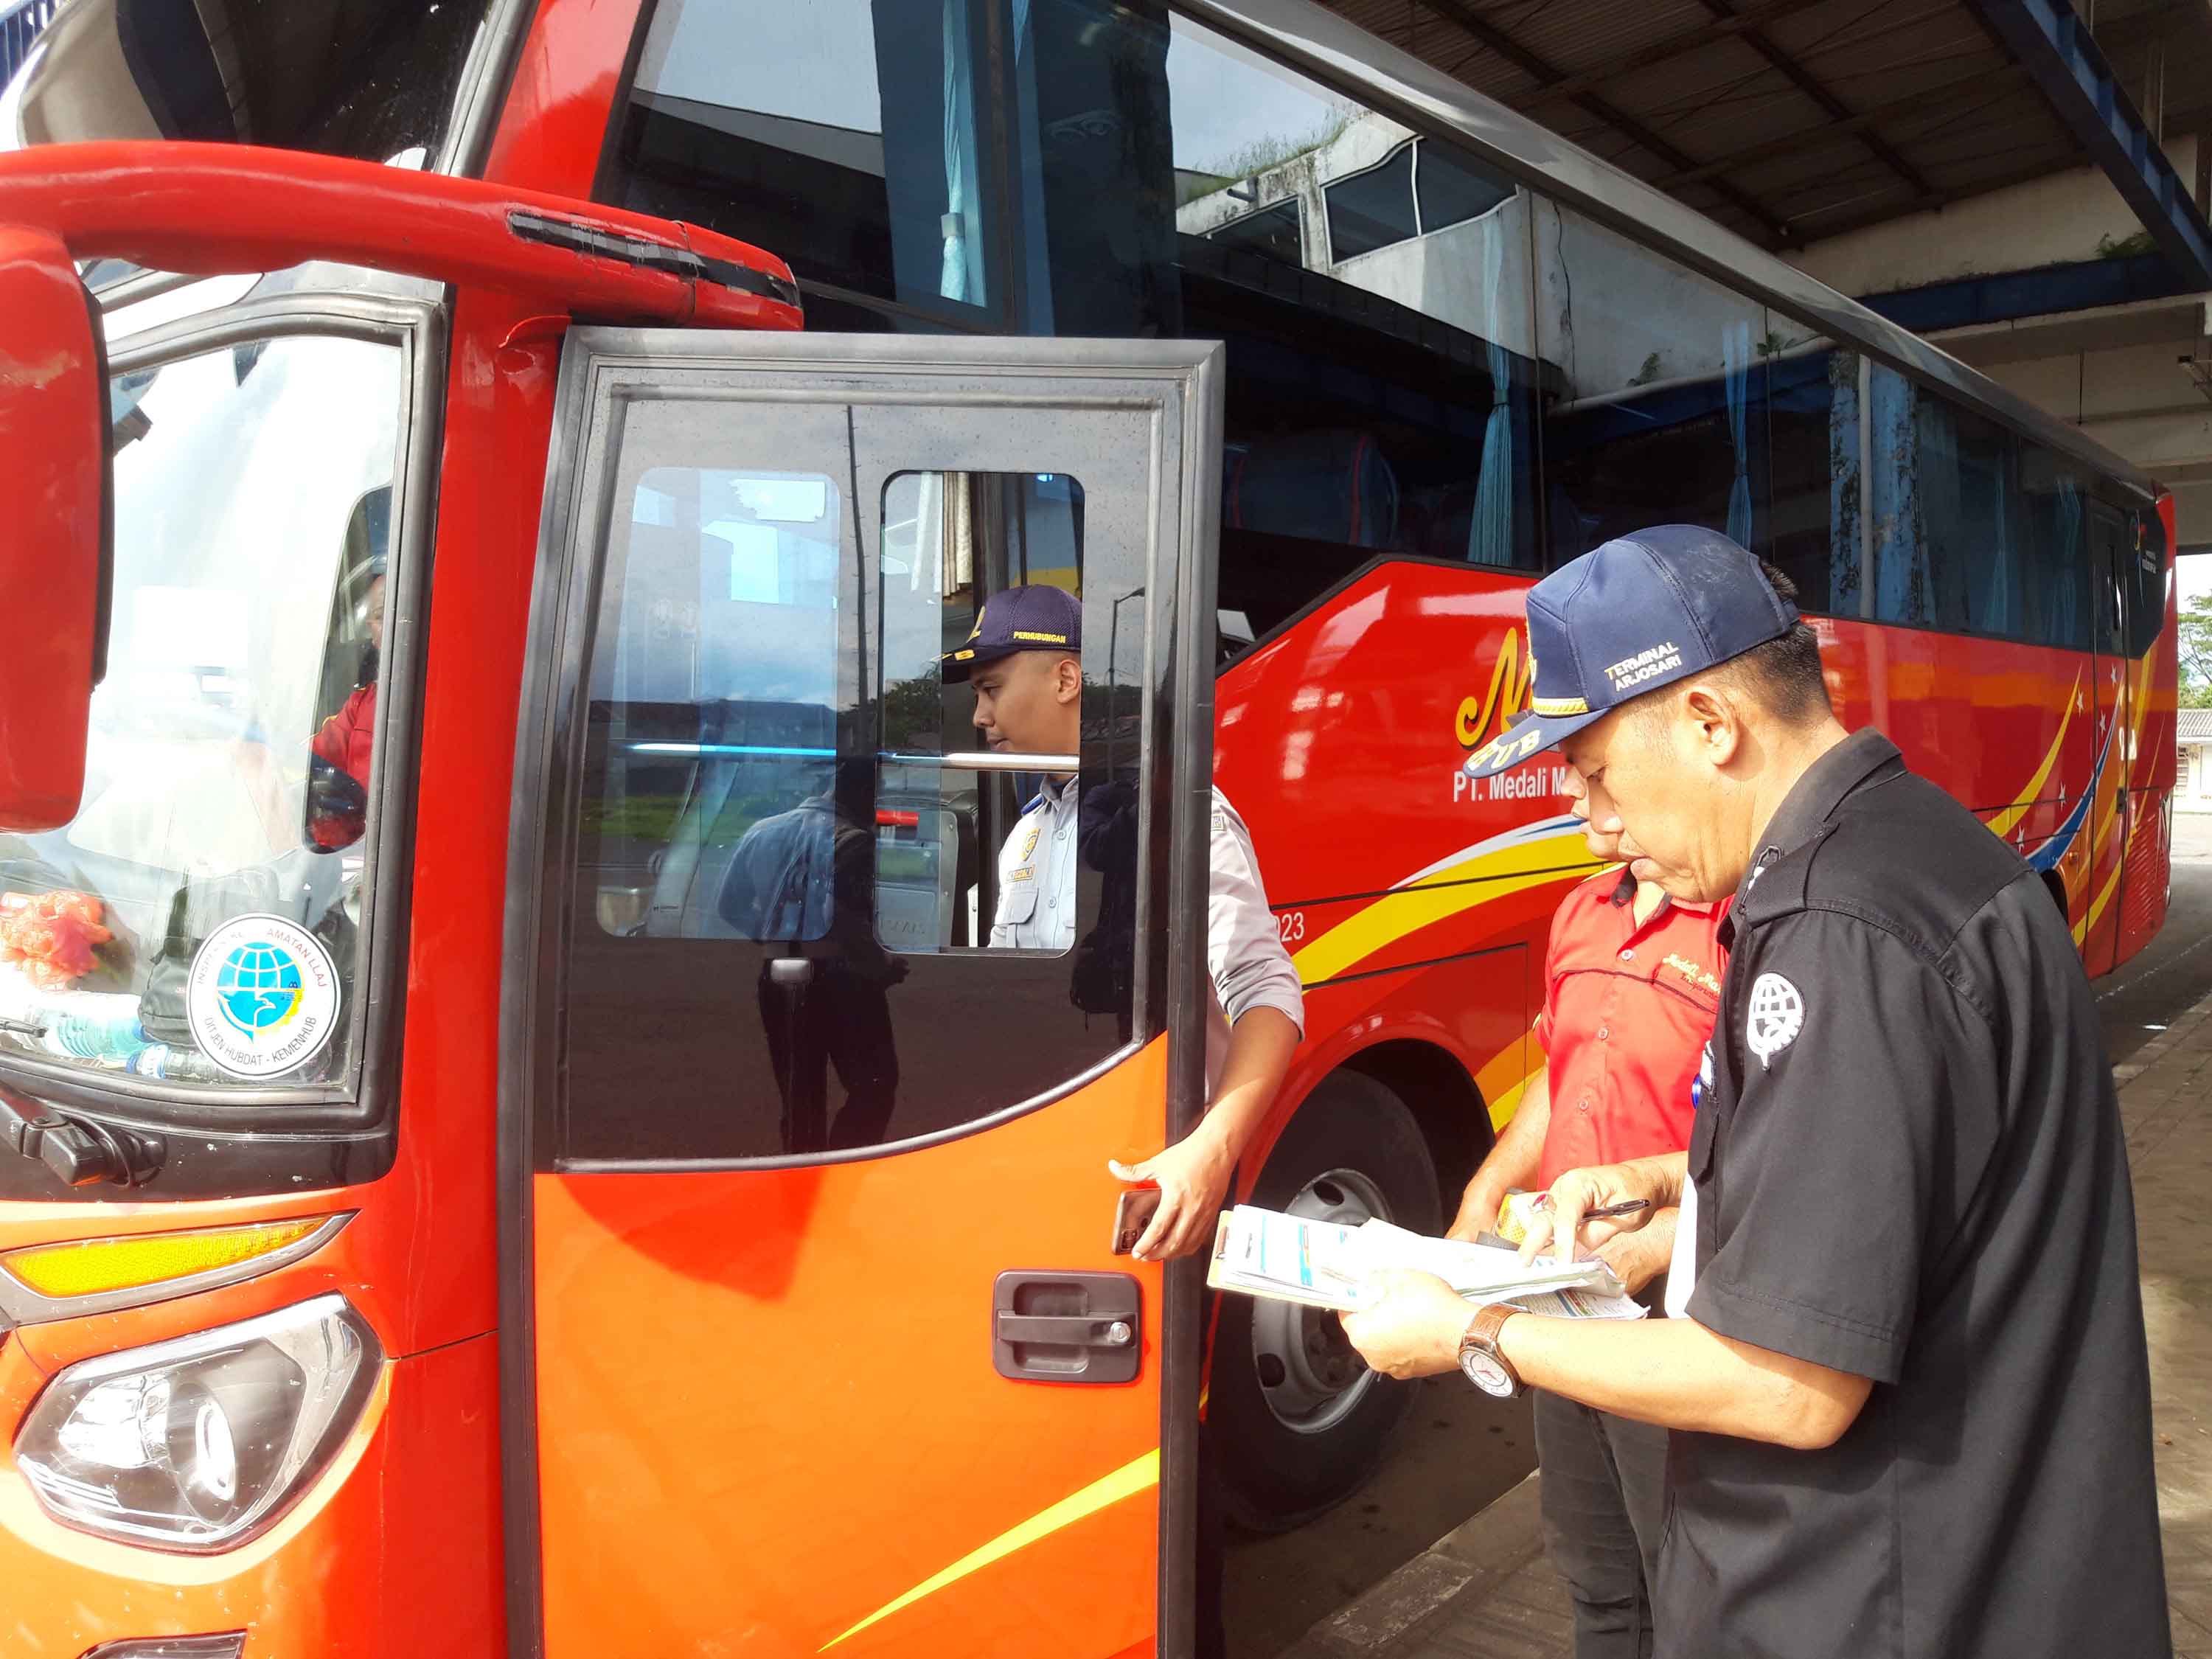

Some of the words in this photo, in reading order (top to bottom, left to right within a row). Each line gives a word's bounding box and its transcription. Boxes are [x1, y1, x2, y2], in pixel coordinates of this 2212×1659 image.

[1013, 630, 1066, 644] PERHUBUNGAN
[1604, 641, 1680, 681] TERMINAL
[1615, 654, 1682, 692] ARJOSARI
[1489, 768, 1546, 800] Medali
[307, 958, 328, 987] LLAJ
[223, 1046, 264, 1067] HUBDAT
[273, 1015, 317, 1064] KEMENHUB
